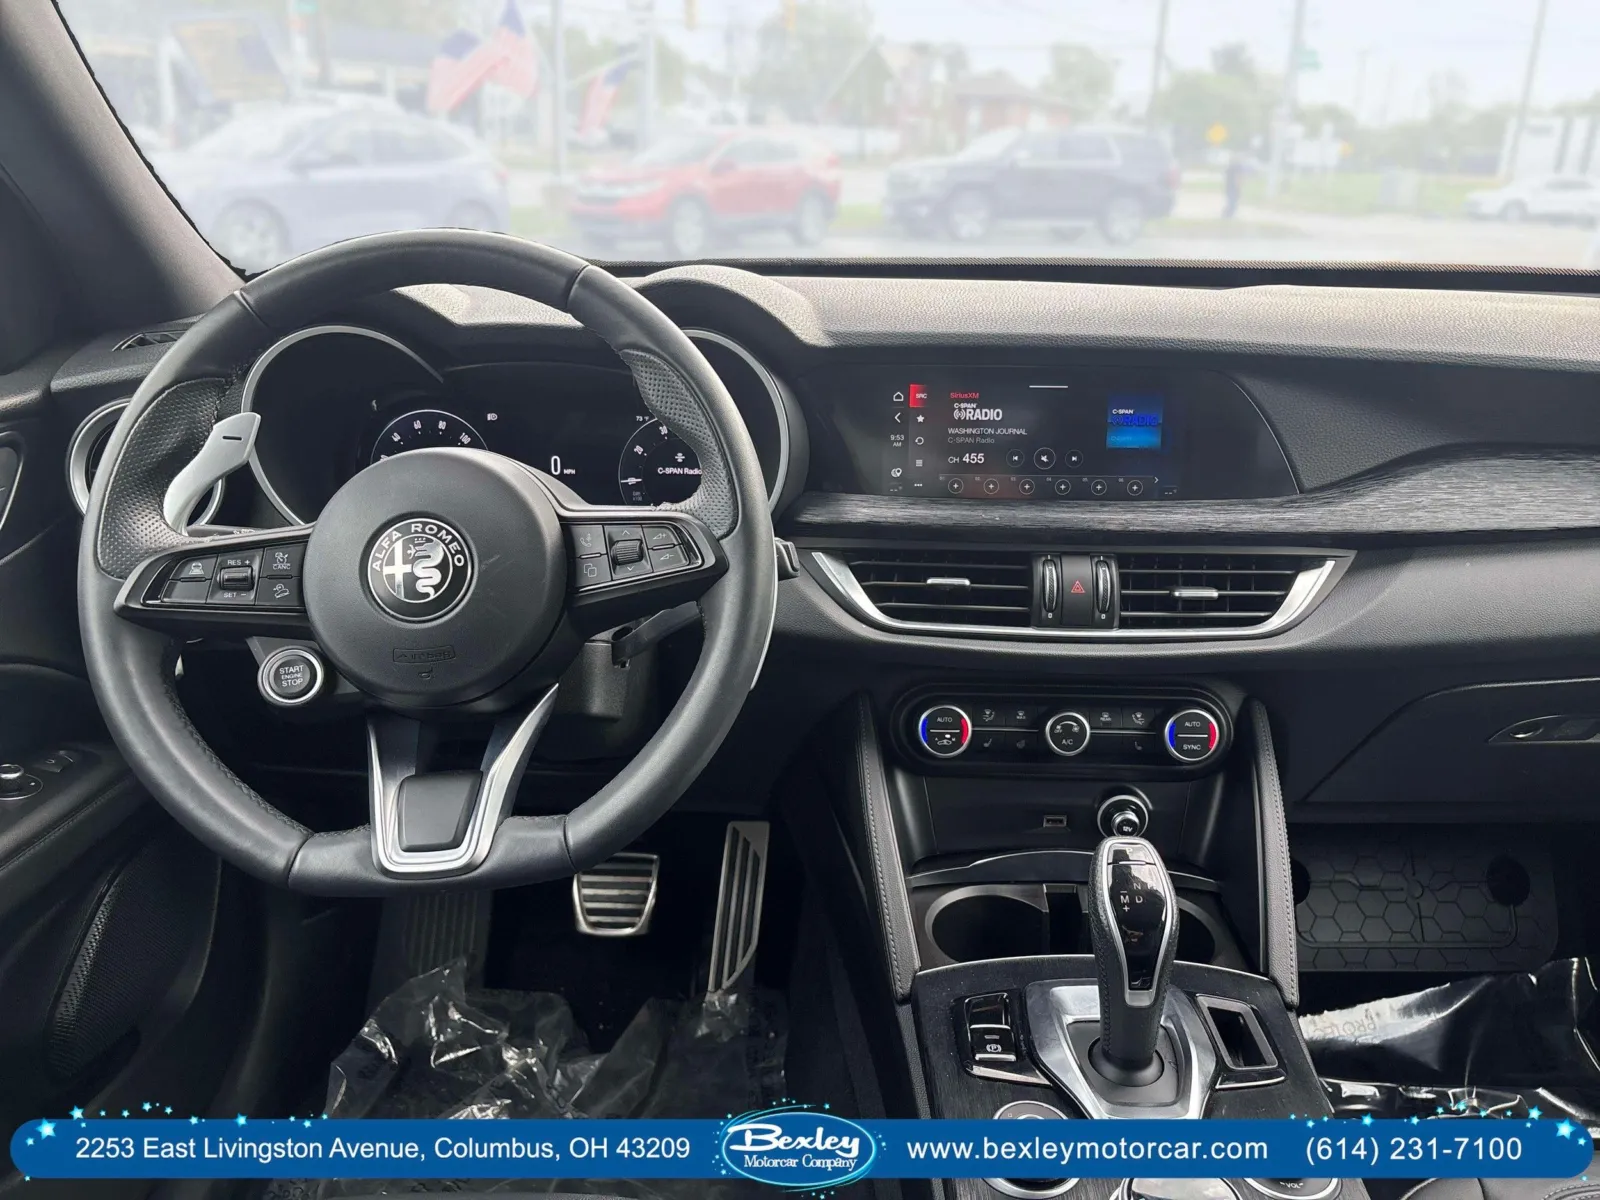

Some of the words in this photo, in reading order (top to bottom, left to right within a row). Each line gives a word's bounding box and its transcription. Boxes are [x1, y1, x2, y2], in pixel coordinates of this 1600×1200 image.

[950, 391, 979, 399] SiriusXM
[965, 408, 1003, 421] RADIO
[948, 427, 994, 435] WASHINGTON
[995, 428, 1028, 436] JOURNAL
[948, 456, 960, 464] CH
[962, 452, 985, 464] 455
[657, 466, 683, 475] C-SPAN
[372, 530, 402, 572] ALFA
[411, 523, 465, 567] ROMEO
[279, 665, 304, 675] START
[282, 678, 303, 687] STOP
